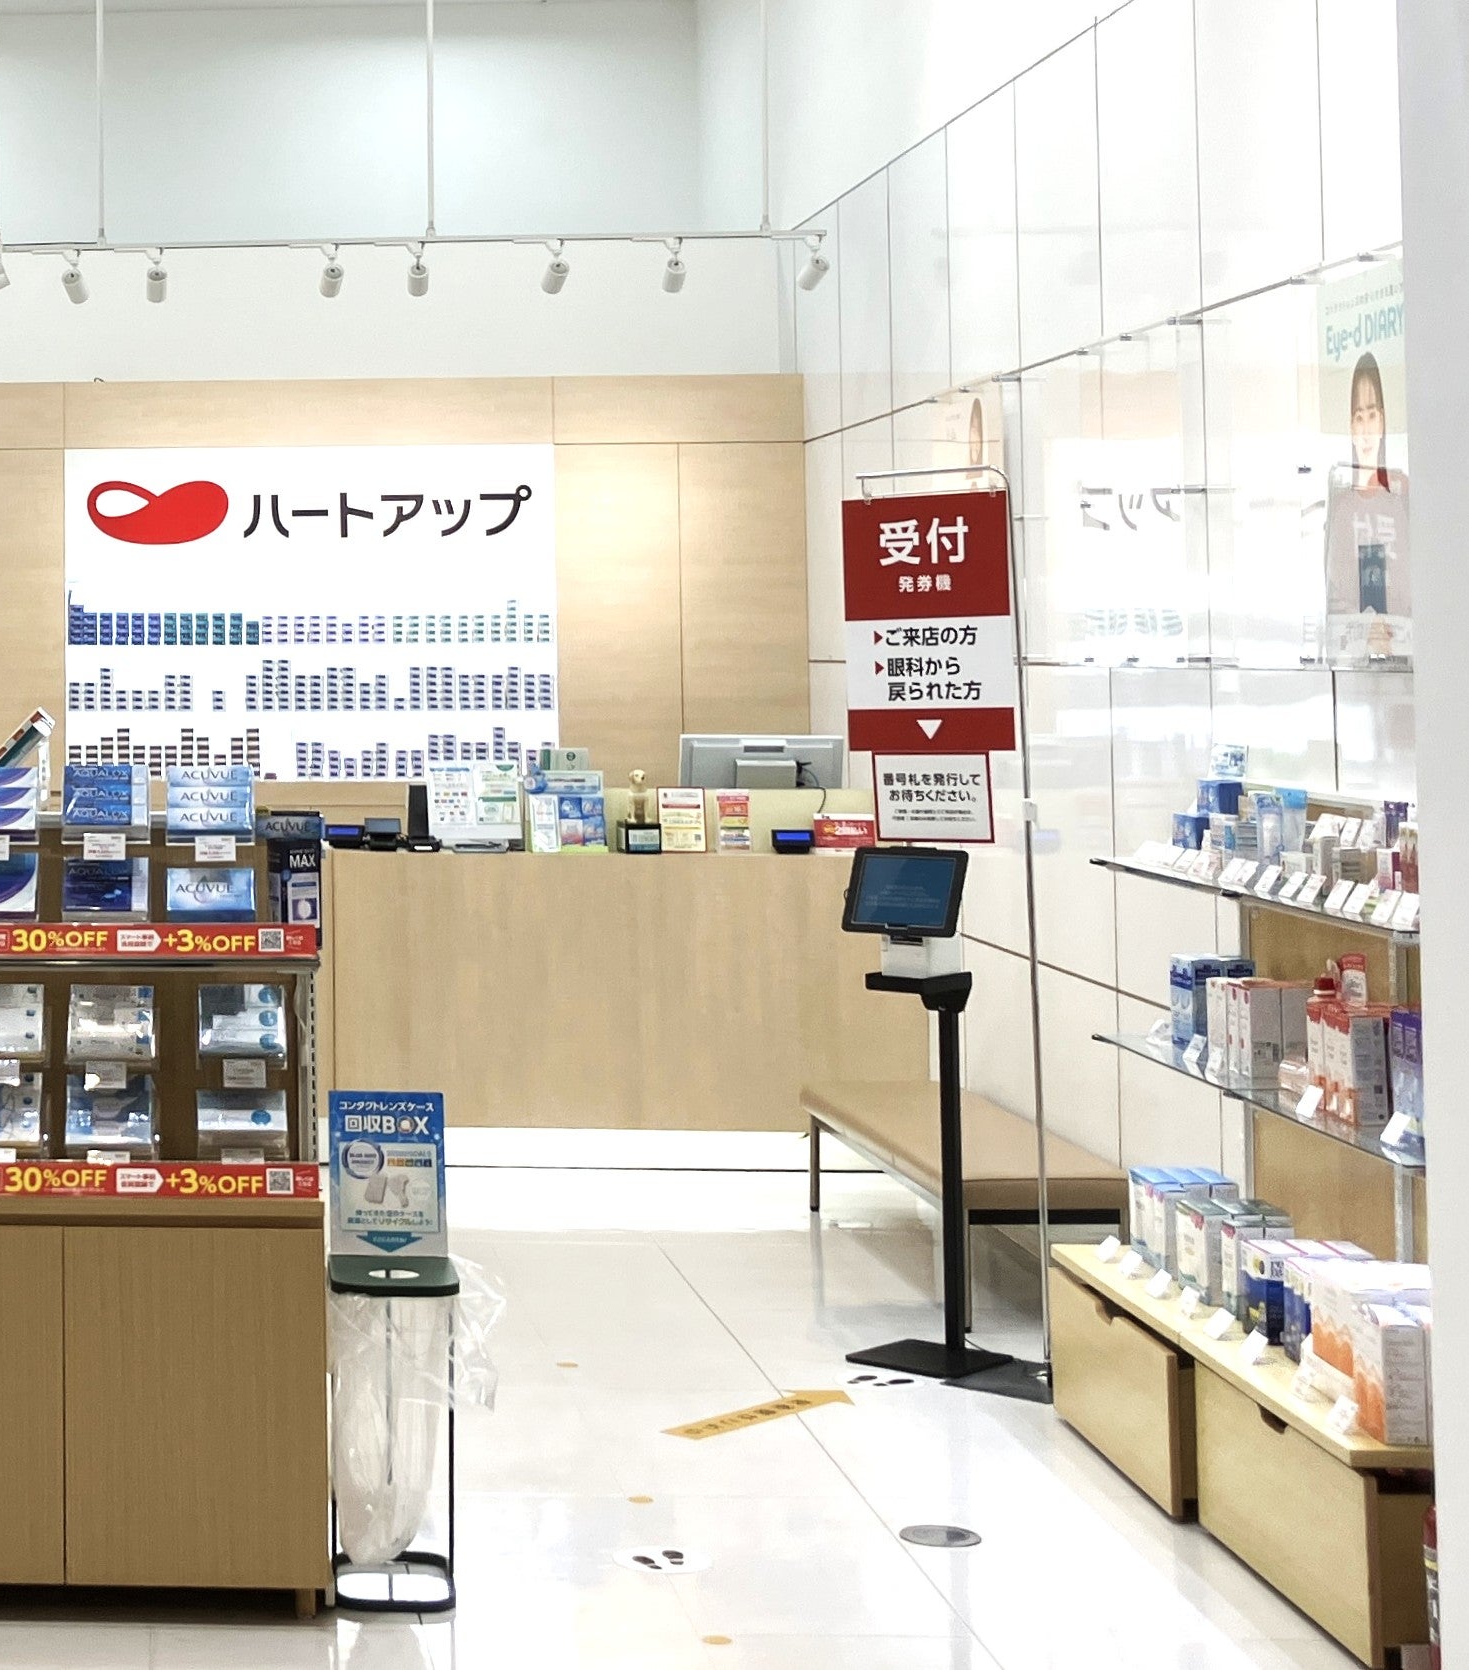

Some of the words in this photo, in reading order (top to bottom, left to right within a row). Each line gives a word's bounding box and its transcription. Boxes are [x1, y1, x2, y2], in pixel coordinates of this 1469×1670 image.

[244, 484, 532, 537] ハートアップ
[879, 516, 969, 567] 受付
[898, 574, 952, 593] 発券機
[885, 625, 978, 647] ご来店の方
[887, 656, 961, 678] 眼科から
[887, 680, 982, 701] 戻られた方
[181, 768, 237, 782] ACUVUE
[883, 773, 981, 786] 番号札を発行して
[181, 788, 237, 802] ACUVUE
[180, 809, 237, 823] ACUVUE
[265, 818, 310, 833] ACUVUE
[289, 854, 316, 869] MAX
[176, 880, 234, 895] ACUVUE
[11, 929, 108, 951] 30%OFF
[163, 929, 256, 952] +3%OFF
[339, 1101, 435, 1112] コンタクトレンズケース
[344, 1114, 429, 1135] 回収BOX
[4, 1166, 108, 1192] 30%OFF
[165, 1168, 264, 1193] +3%OFF
